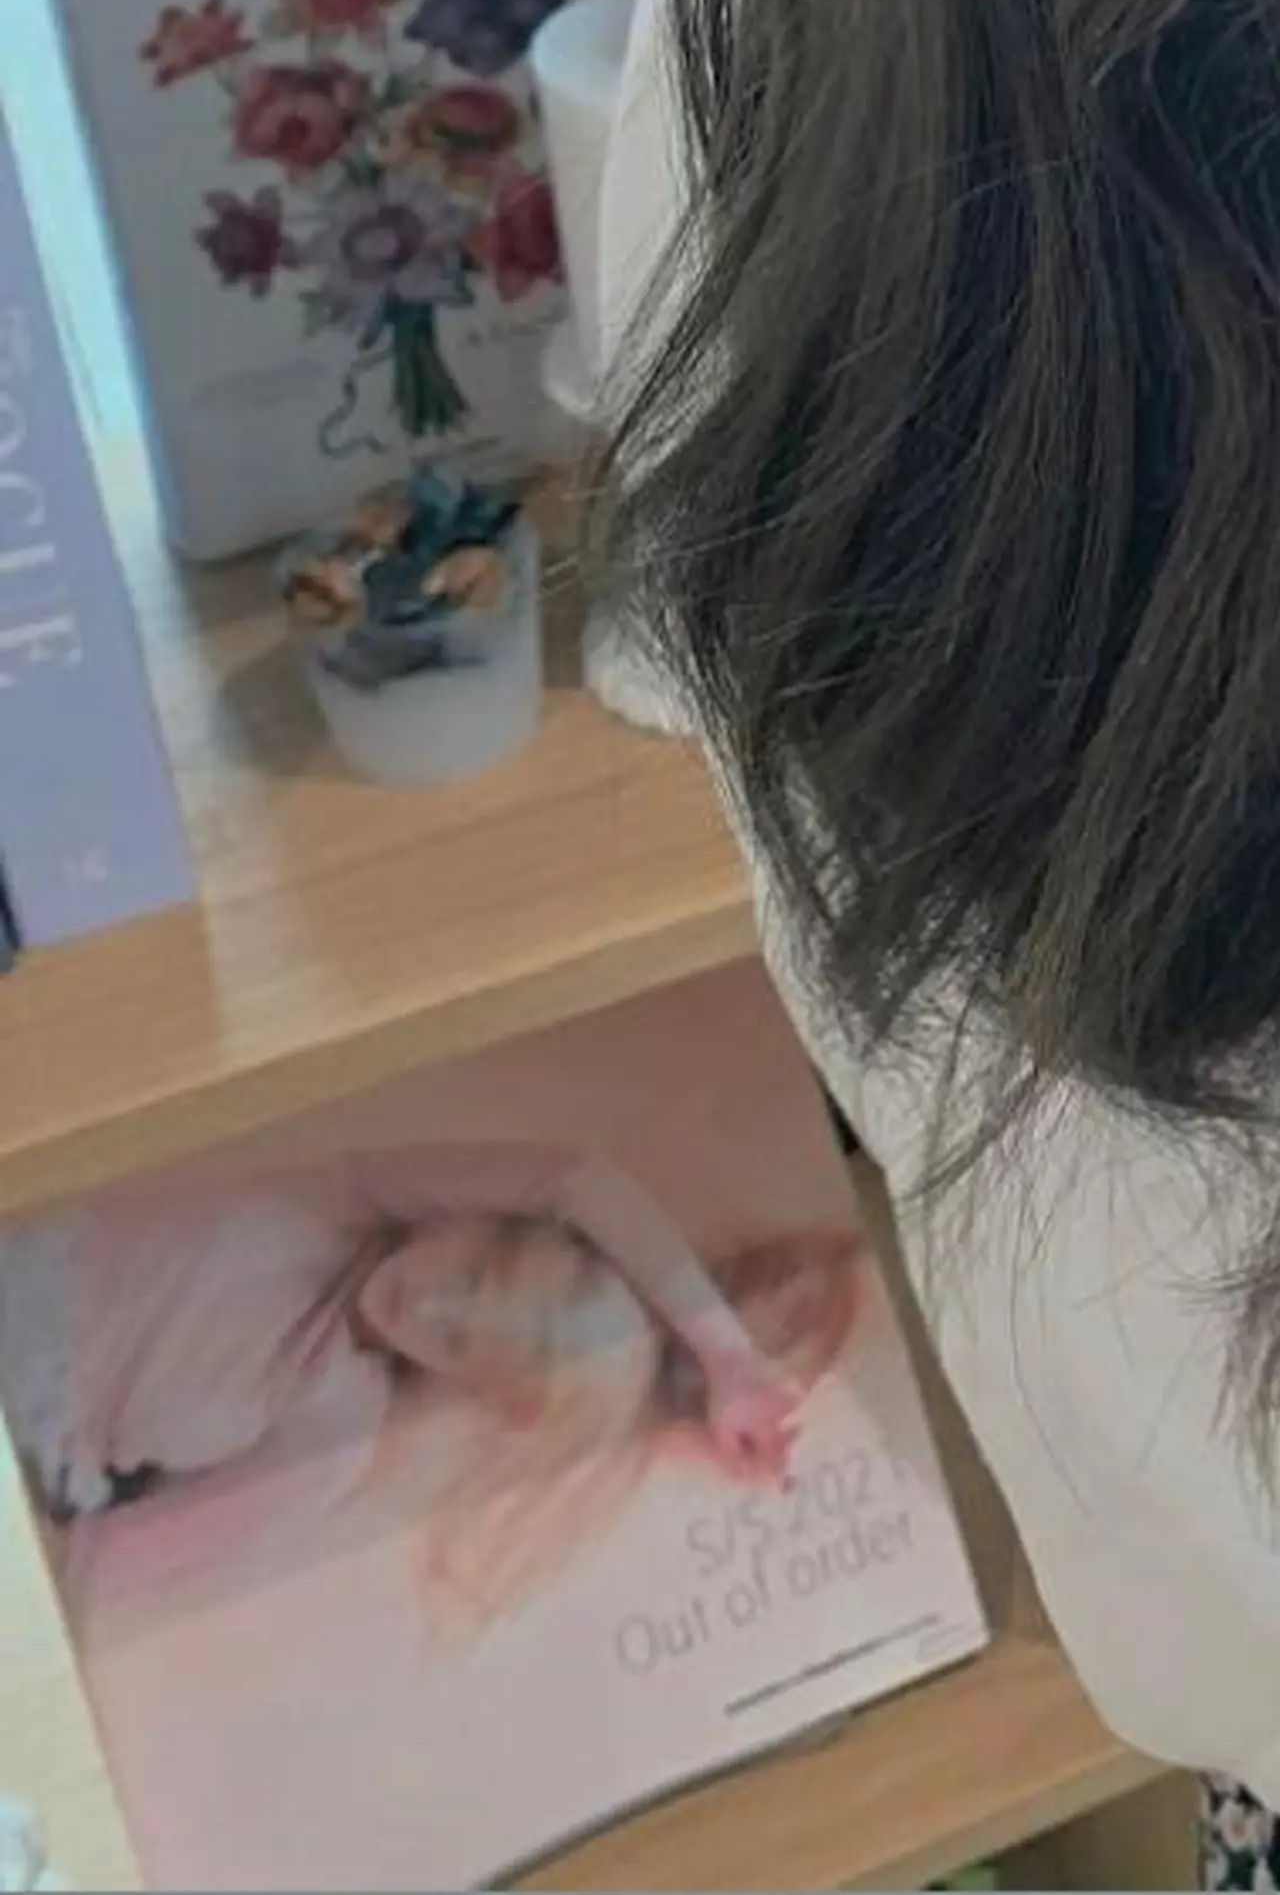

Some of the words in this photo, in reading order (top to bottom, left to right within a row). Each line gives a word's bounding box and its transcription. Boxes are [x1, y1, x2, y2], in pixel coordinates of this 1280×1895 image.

[613, 1590, 712, 1675] Out
[724, 1546, 773, 1629] of
[784, 1508, 914, 1596] order
